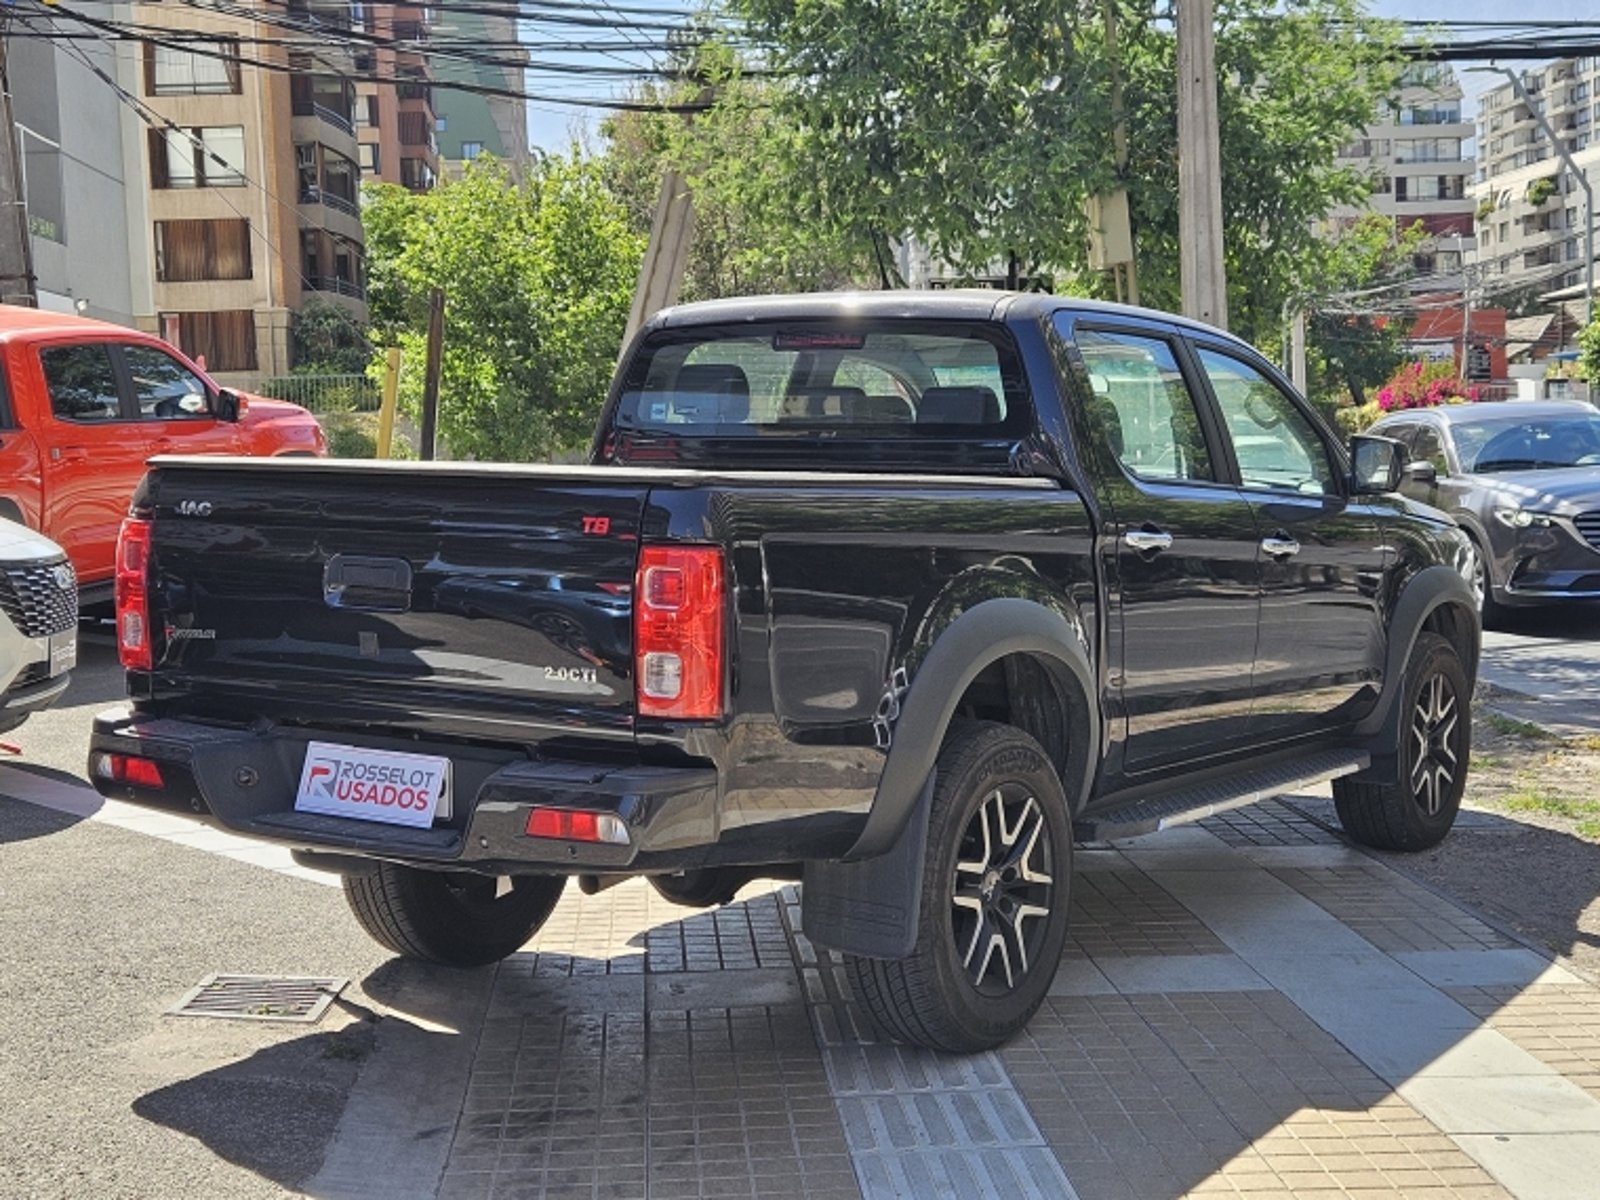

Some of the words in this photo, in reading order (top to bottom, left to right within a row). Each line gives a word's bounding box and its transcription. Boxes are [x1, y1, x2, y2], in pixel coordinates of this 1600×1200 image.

[582, 517, 609, 534] T8
[341, 761, 434, 788] ROSSELOT
[336, 780, 429, 811] USADOS
